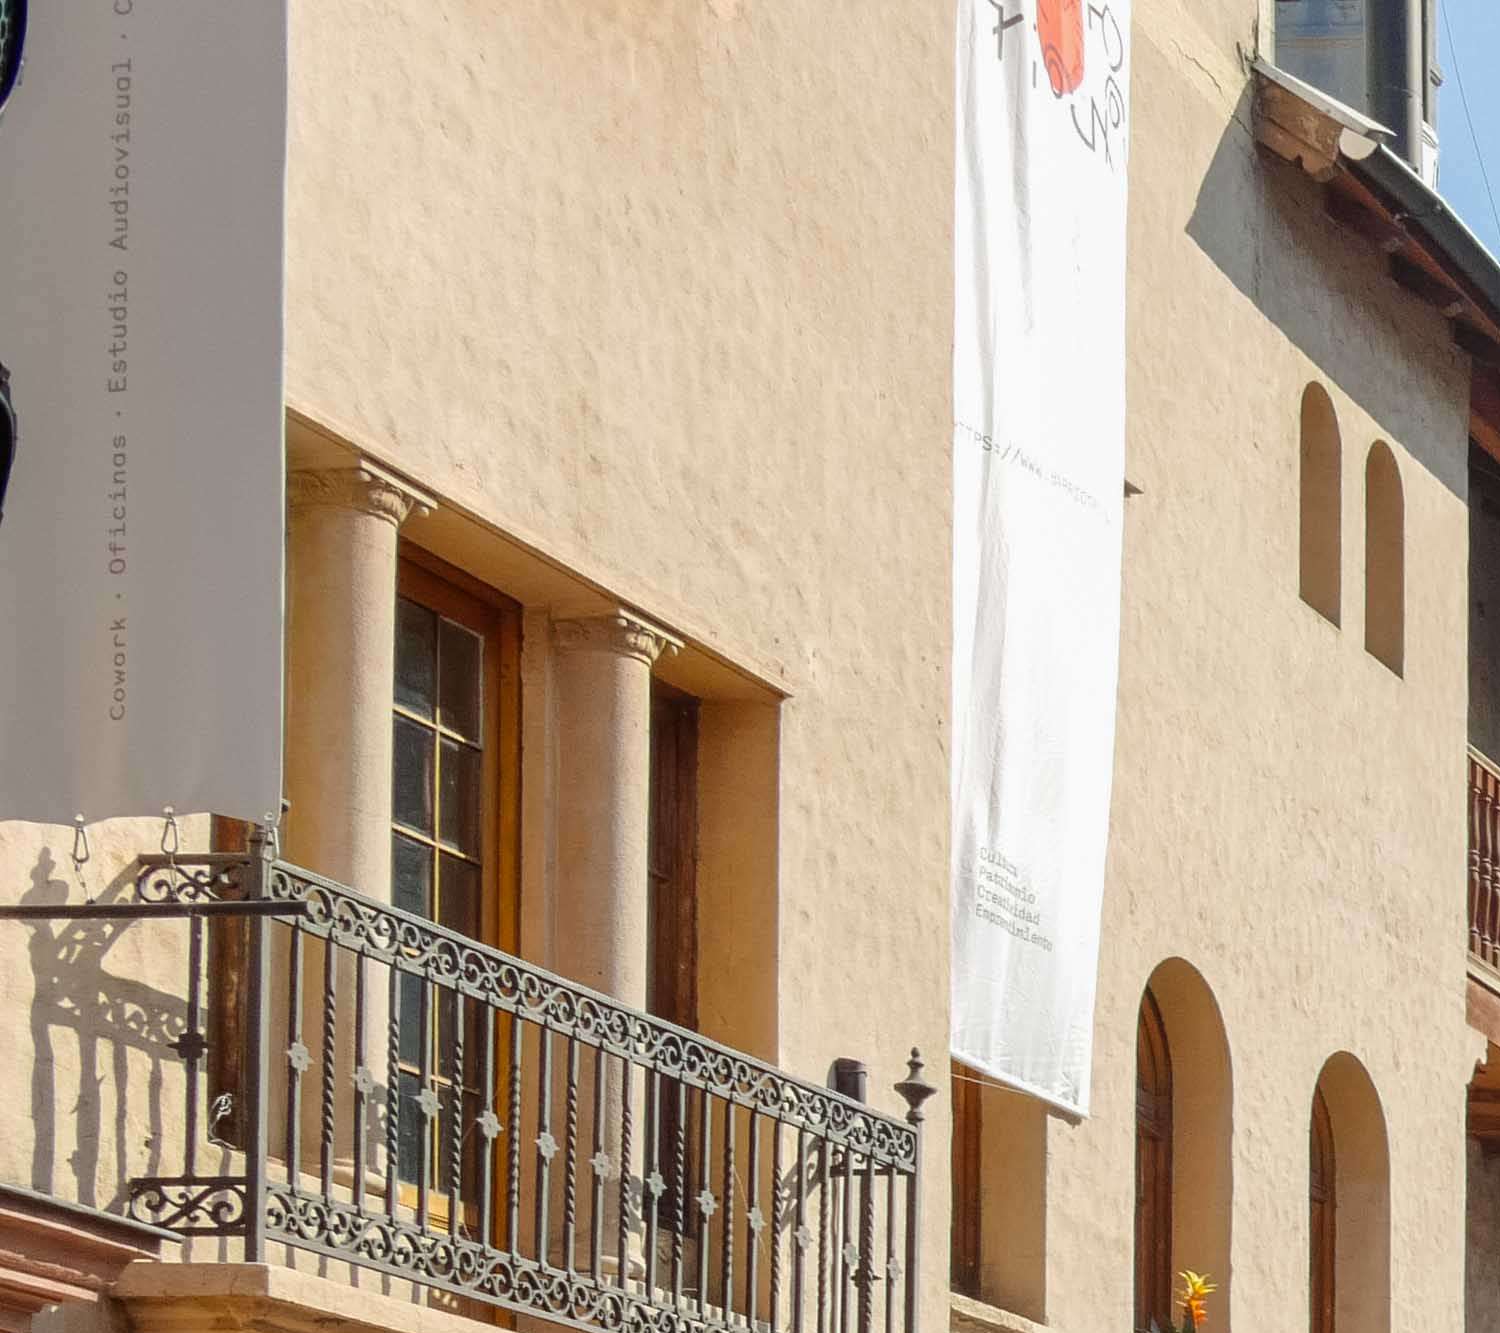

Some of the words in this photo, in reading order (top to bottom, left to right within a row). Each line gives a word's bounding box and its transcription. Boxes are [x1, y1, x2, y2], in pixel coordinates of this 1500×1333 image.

[109, 57, 132, 251] Audiovisual
[108, 270, 128, 393] Estudio
[108, 434, 127, 575] Oficinas
[109, 617, 127, 721] Cowork
